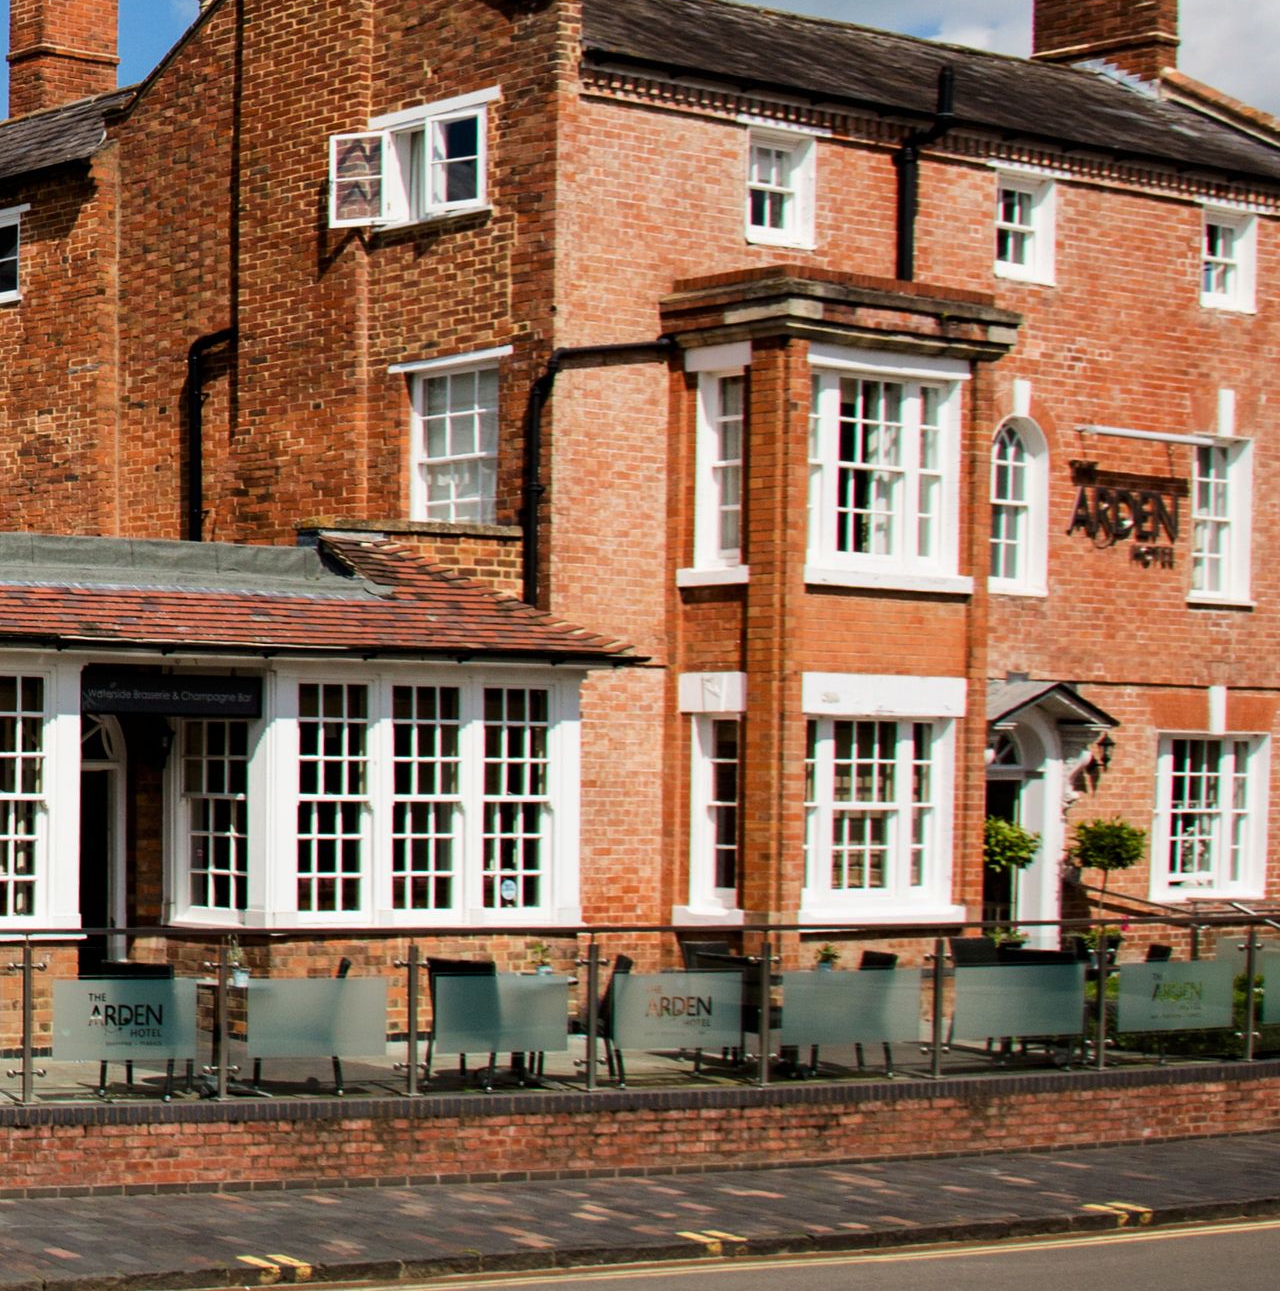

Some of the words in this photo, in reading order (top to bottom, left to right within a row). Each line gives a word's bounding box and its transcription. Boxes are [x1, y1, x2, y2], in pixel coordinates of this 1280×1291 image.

[1067, 486, 1179, 544] ARDEN
[88, 689, 131, 699] Waterside
[133, 689, 170, 700] Brasserie
[172, 691, 178, 700] &
[181, 691, 236, 704] Champagne
[238, 692, 252, 702] Bar
[88, 993, 107, 1002] THE
[645, 996, 712, 1017] ARDEN
[88, 1004, 163, 1026] ARDEN
[130, 1028, 162, 1037] HOTEL
